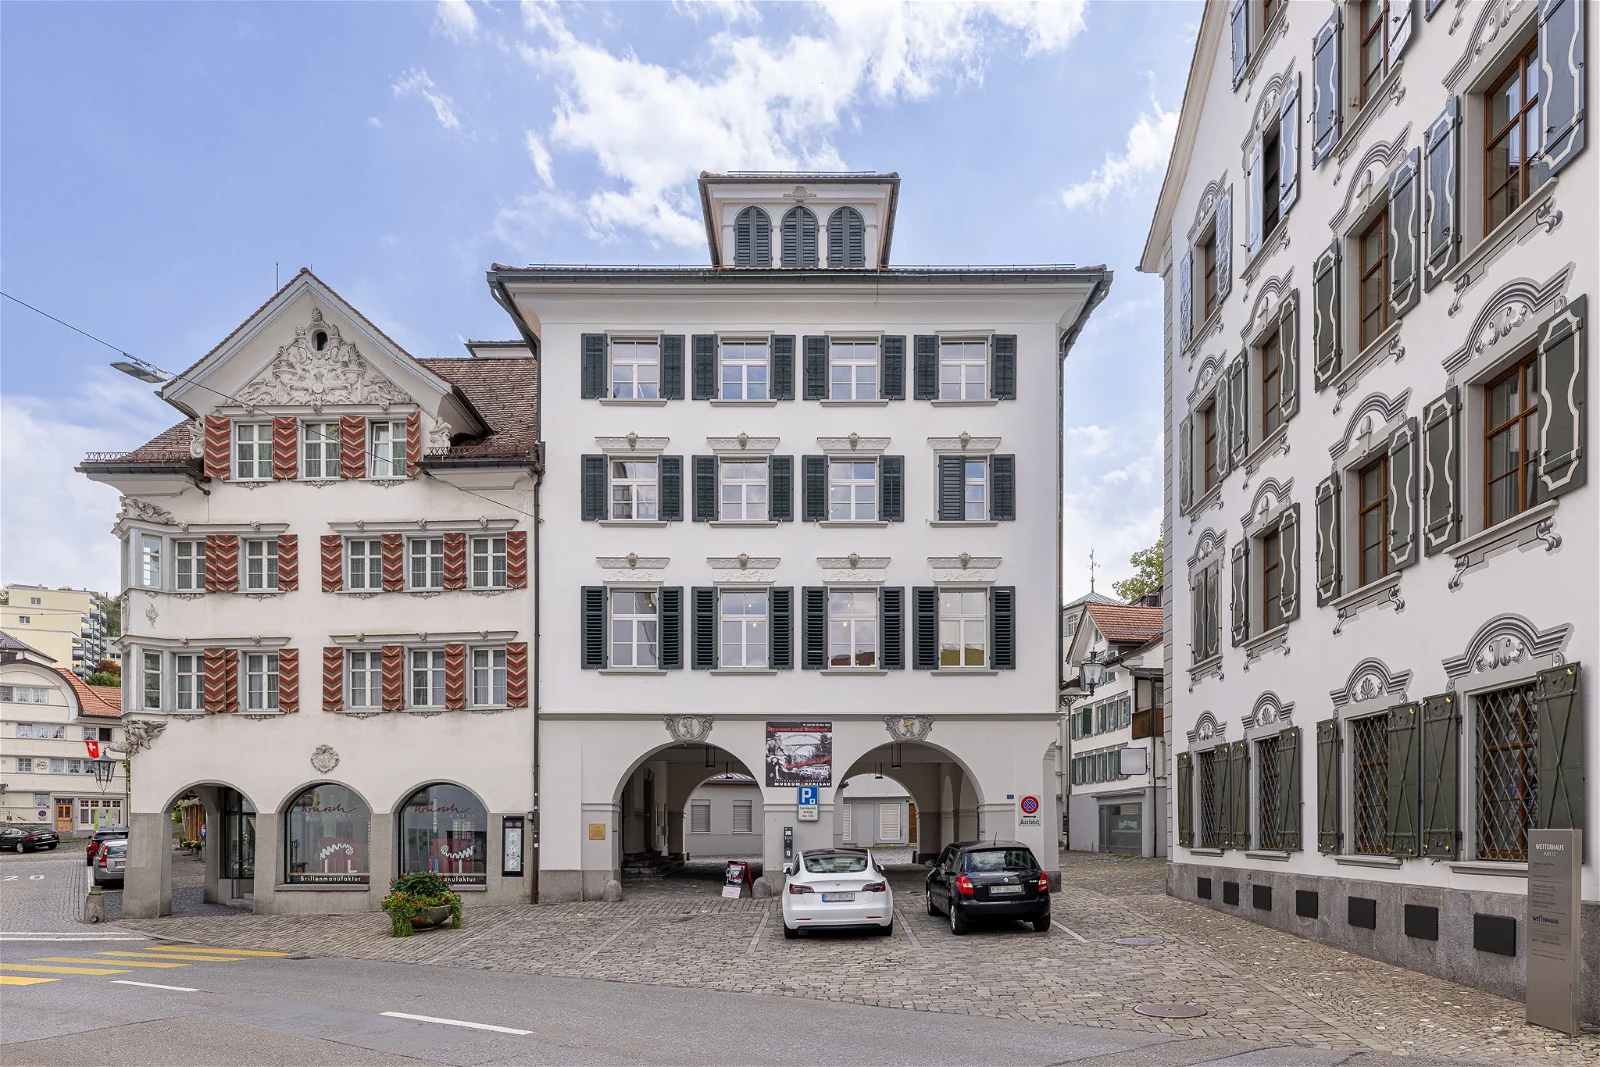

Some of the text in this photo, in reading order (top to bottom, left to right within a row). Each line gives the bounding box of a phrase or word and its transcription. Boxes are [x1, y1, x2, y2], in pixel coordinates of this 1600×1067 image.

[801, 787, 811, 803] P
[1535, 843, 1564, 851] WETTERHAUS
[1532, 915, 1559, 925] WETTERHAUS
